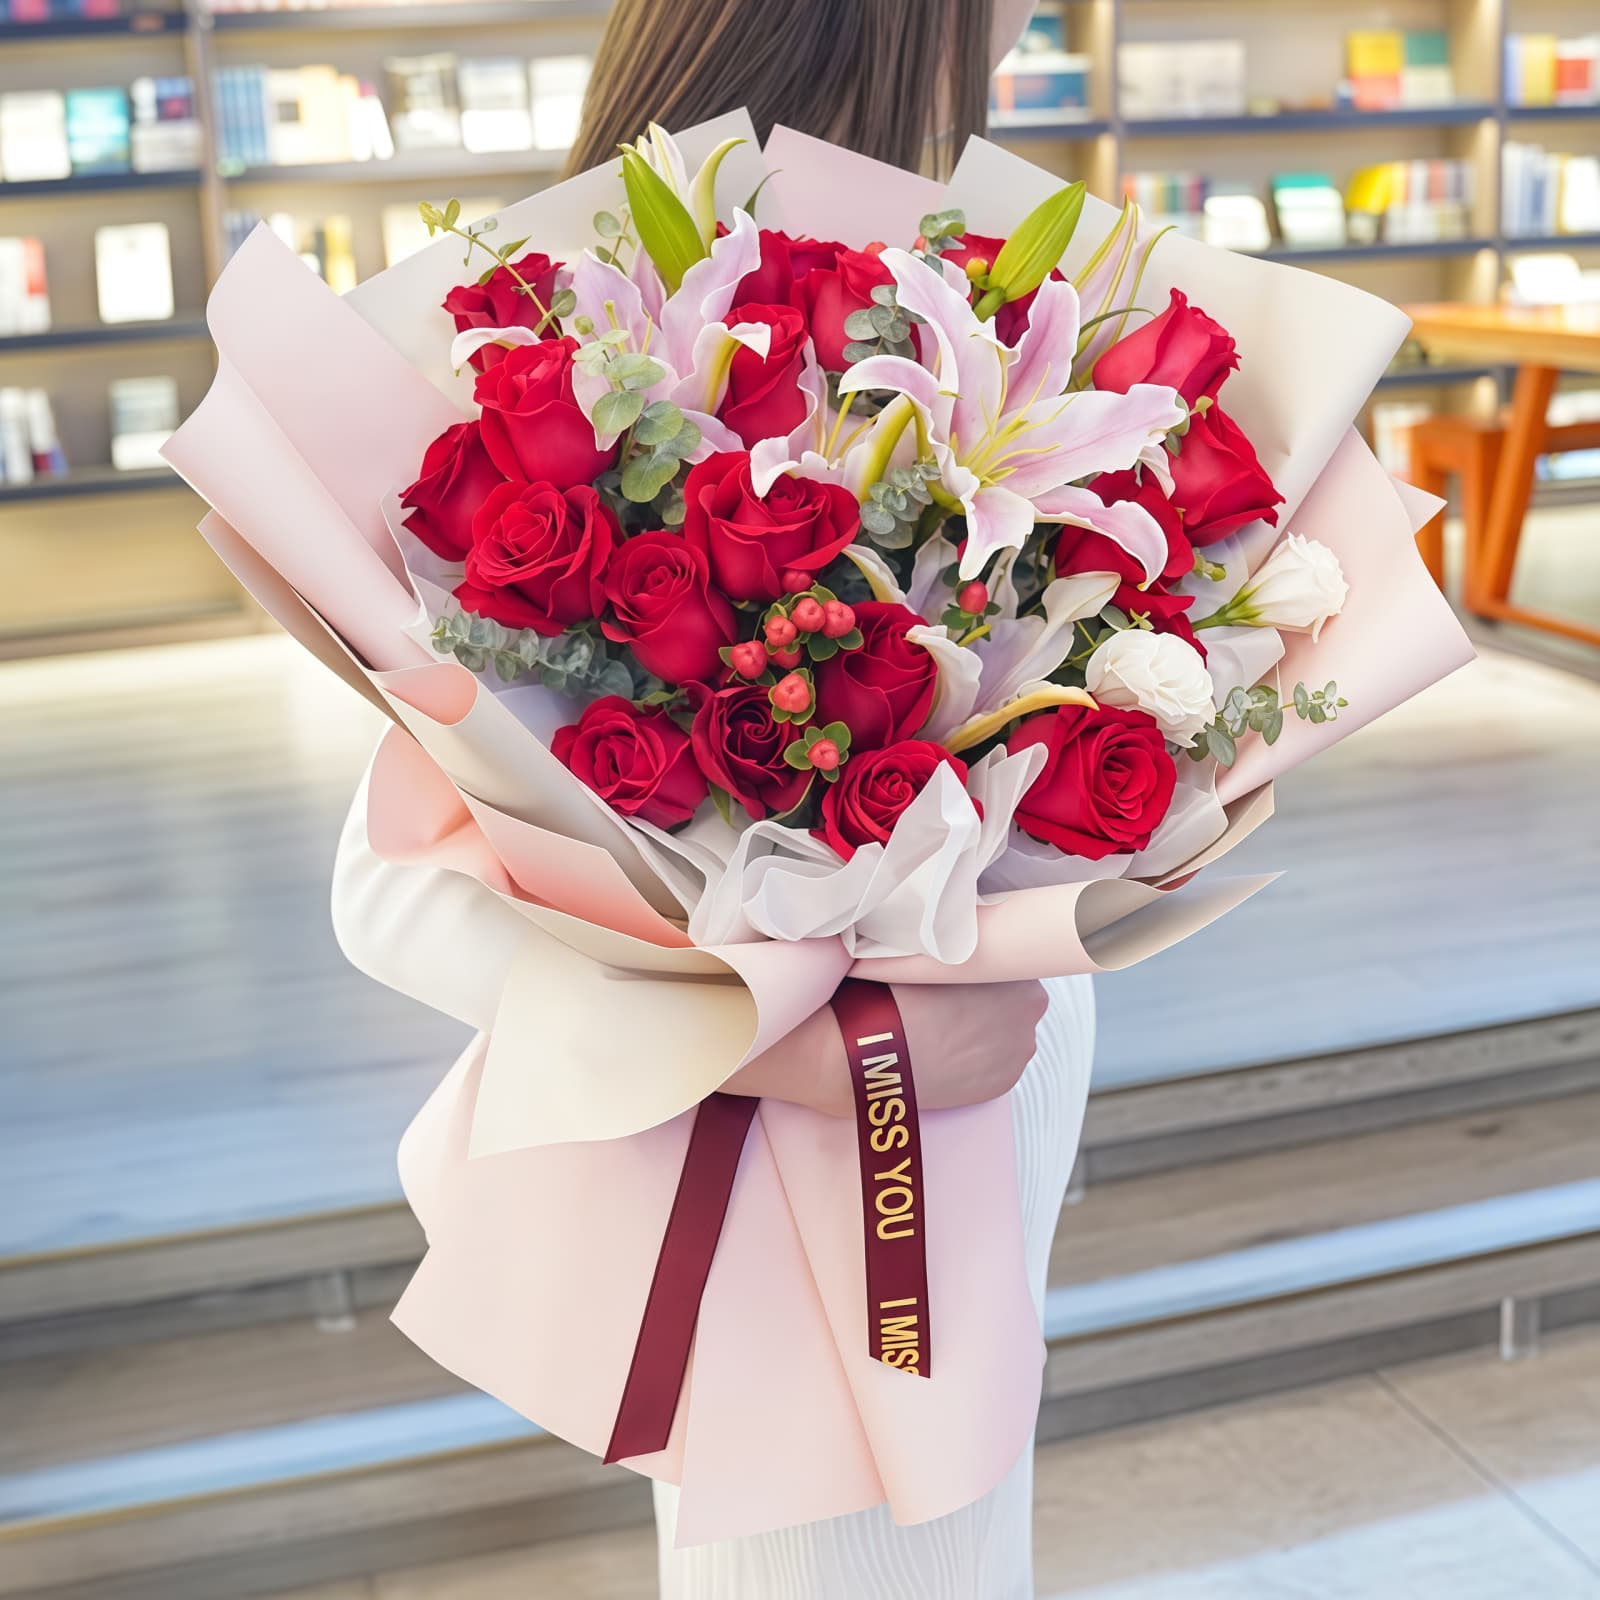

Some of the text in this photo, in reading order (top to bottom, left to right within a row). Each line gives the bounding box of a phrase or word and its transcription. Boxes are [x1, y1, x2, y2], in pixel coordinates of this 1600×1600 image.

[857, 1032, 914, 1240] I MISS YOU
[880, 1297, 919, 1376] I MIS
